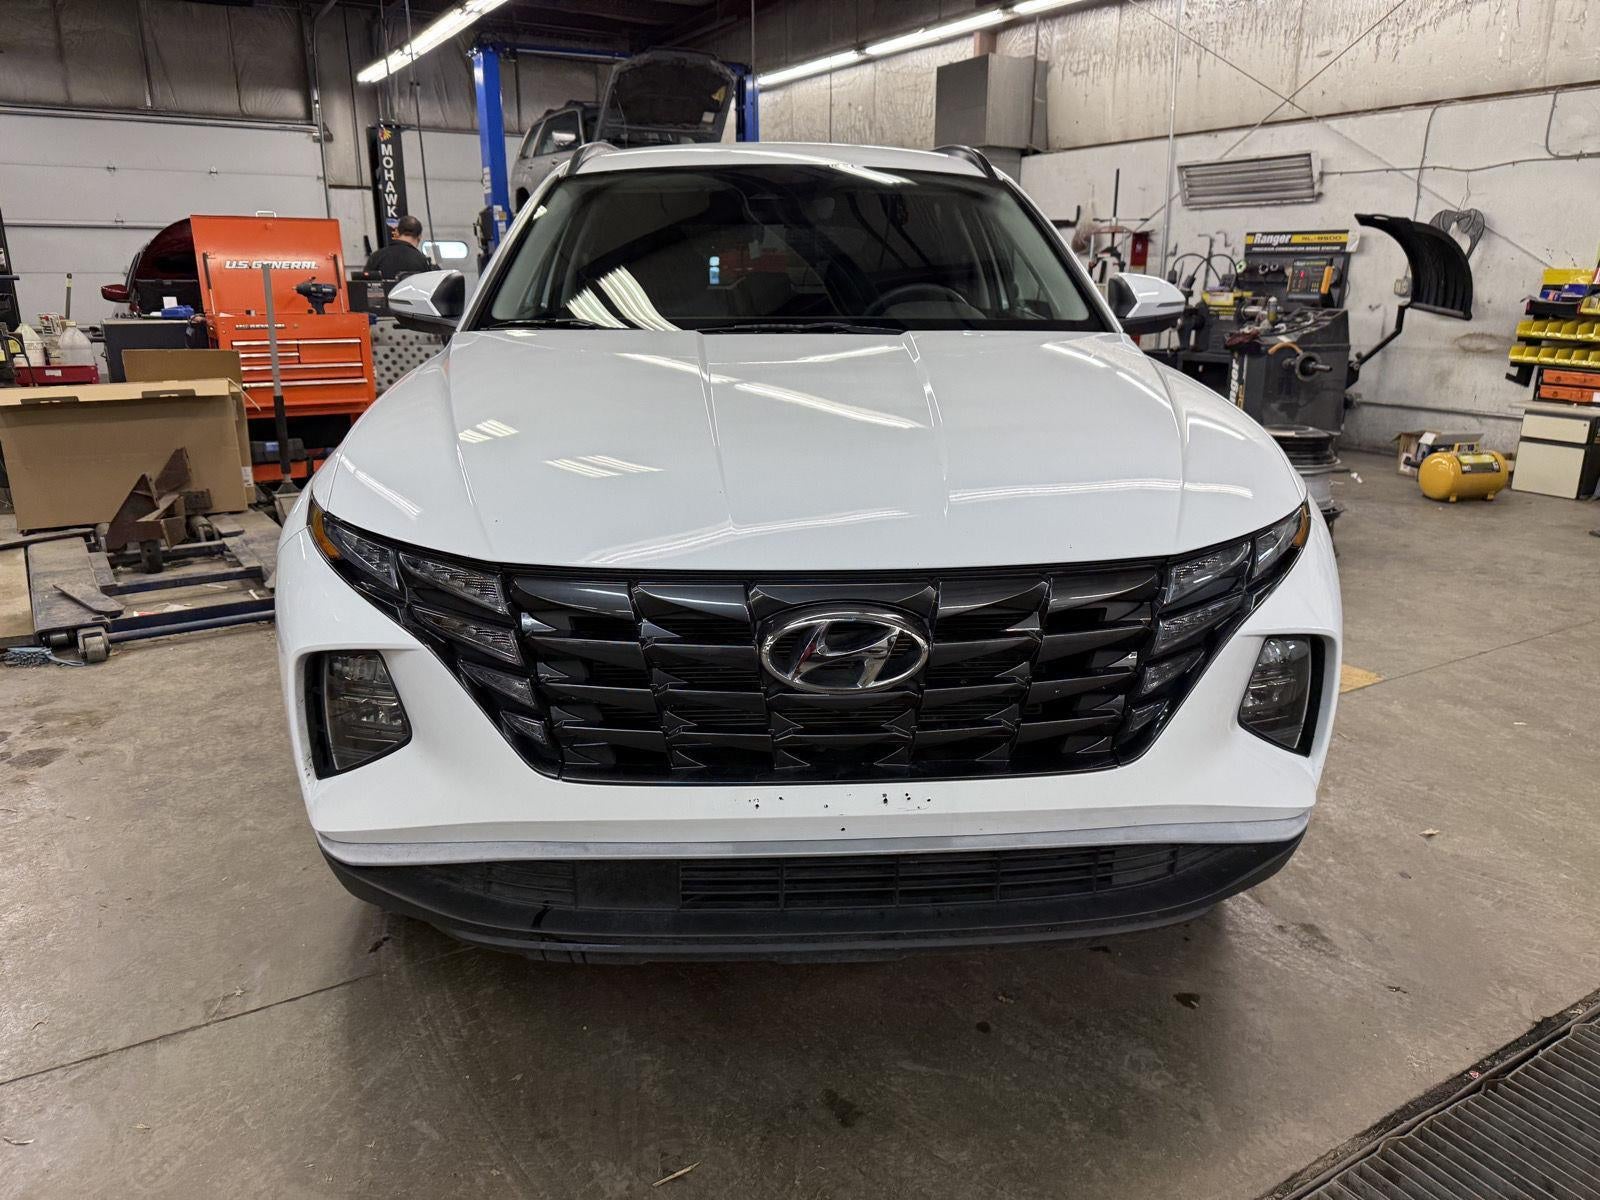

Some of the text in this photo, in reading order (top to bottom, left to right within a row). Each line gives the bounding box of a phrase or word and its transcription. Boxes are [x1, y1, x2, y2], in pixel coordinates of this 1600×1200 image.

[381, 143, 398, 217] MOHAWK
[1254, 233, 1291, 246] Ranger
[1229, 359, 1238, 403] nger
